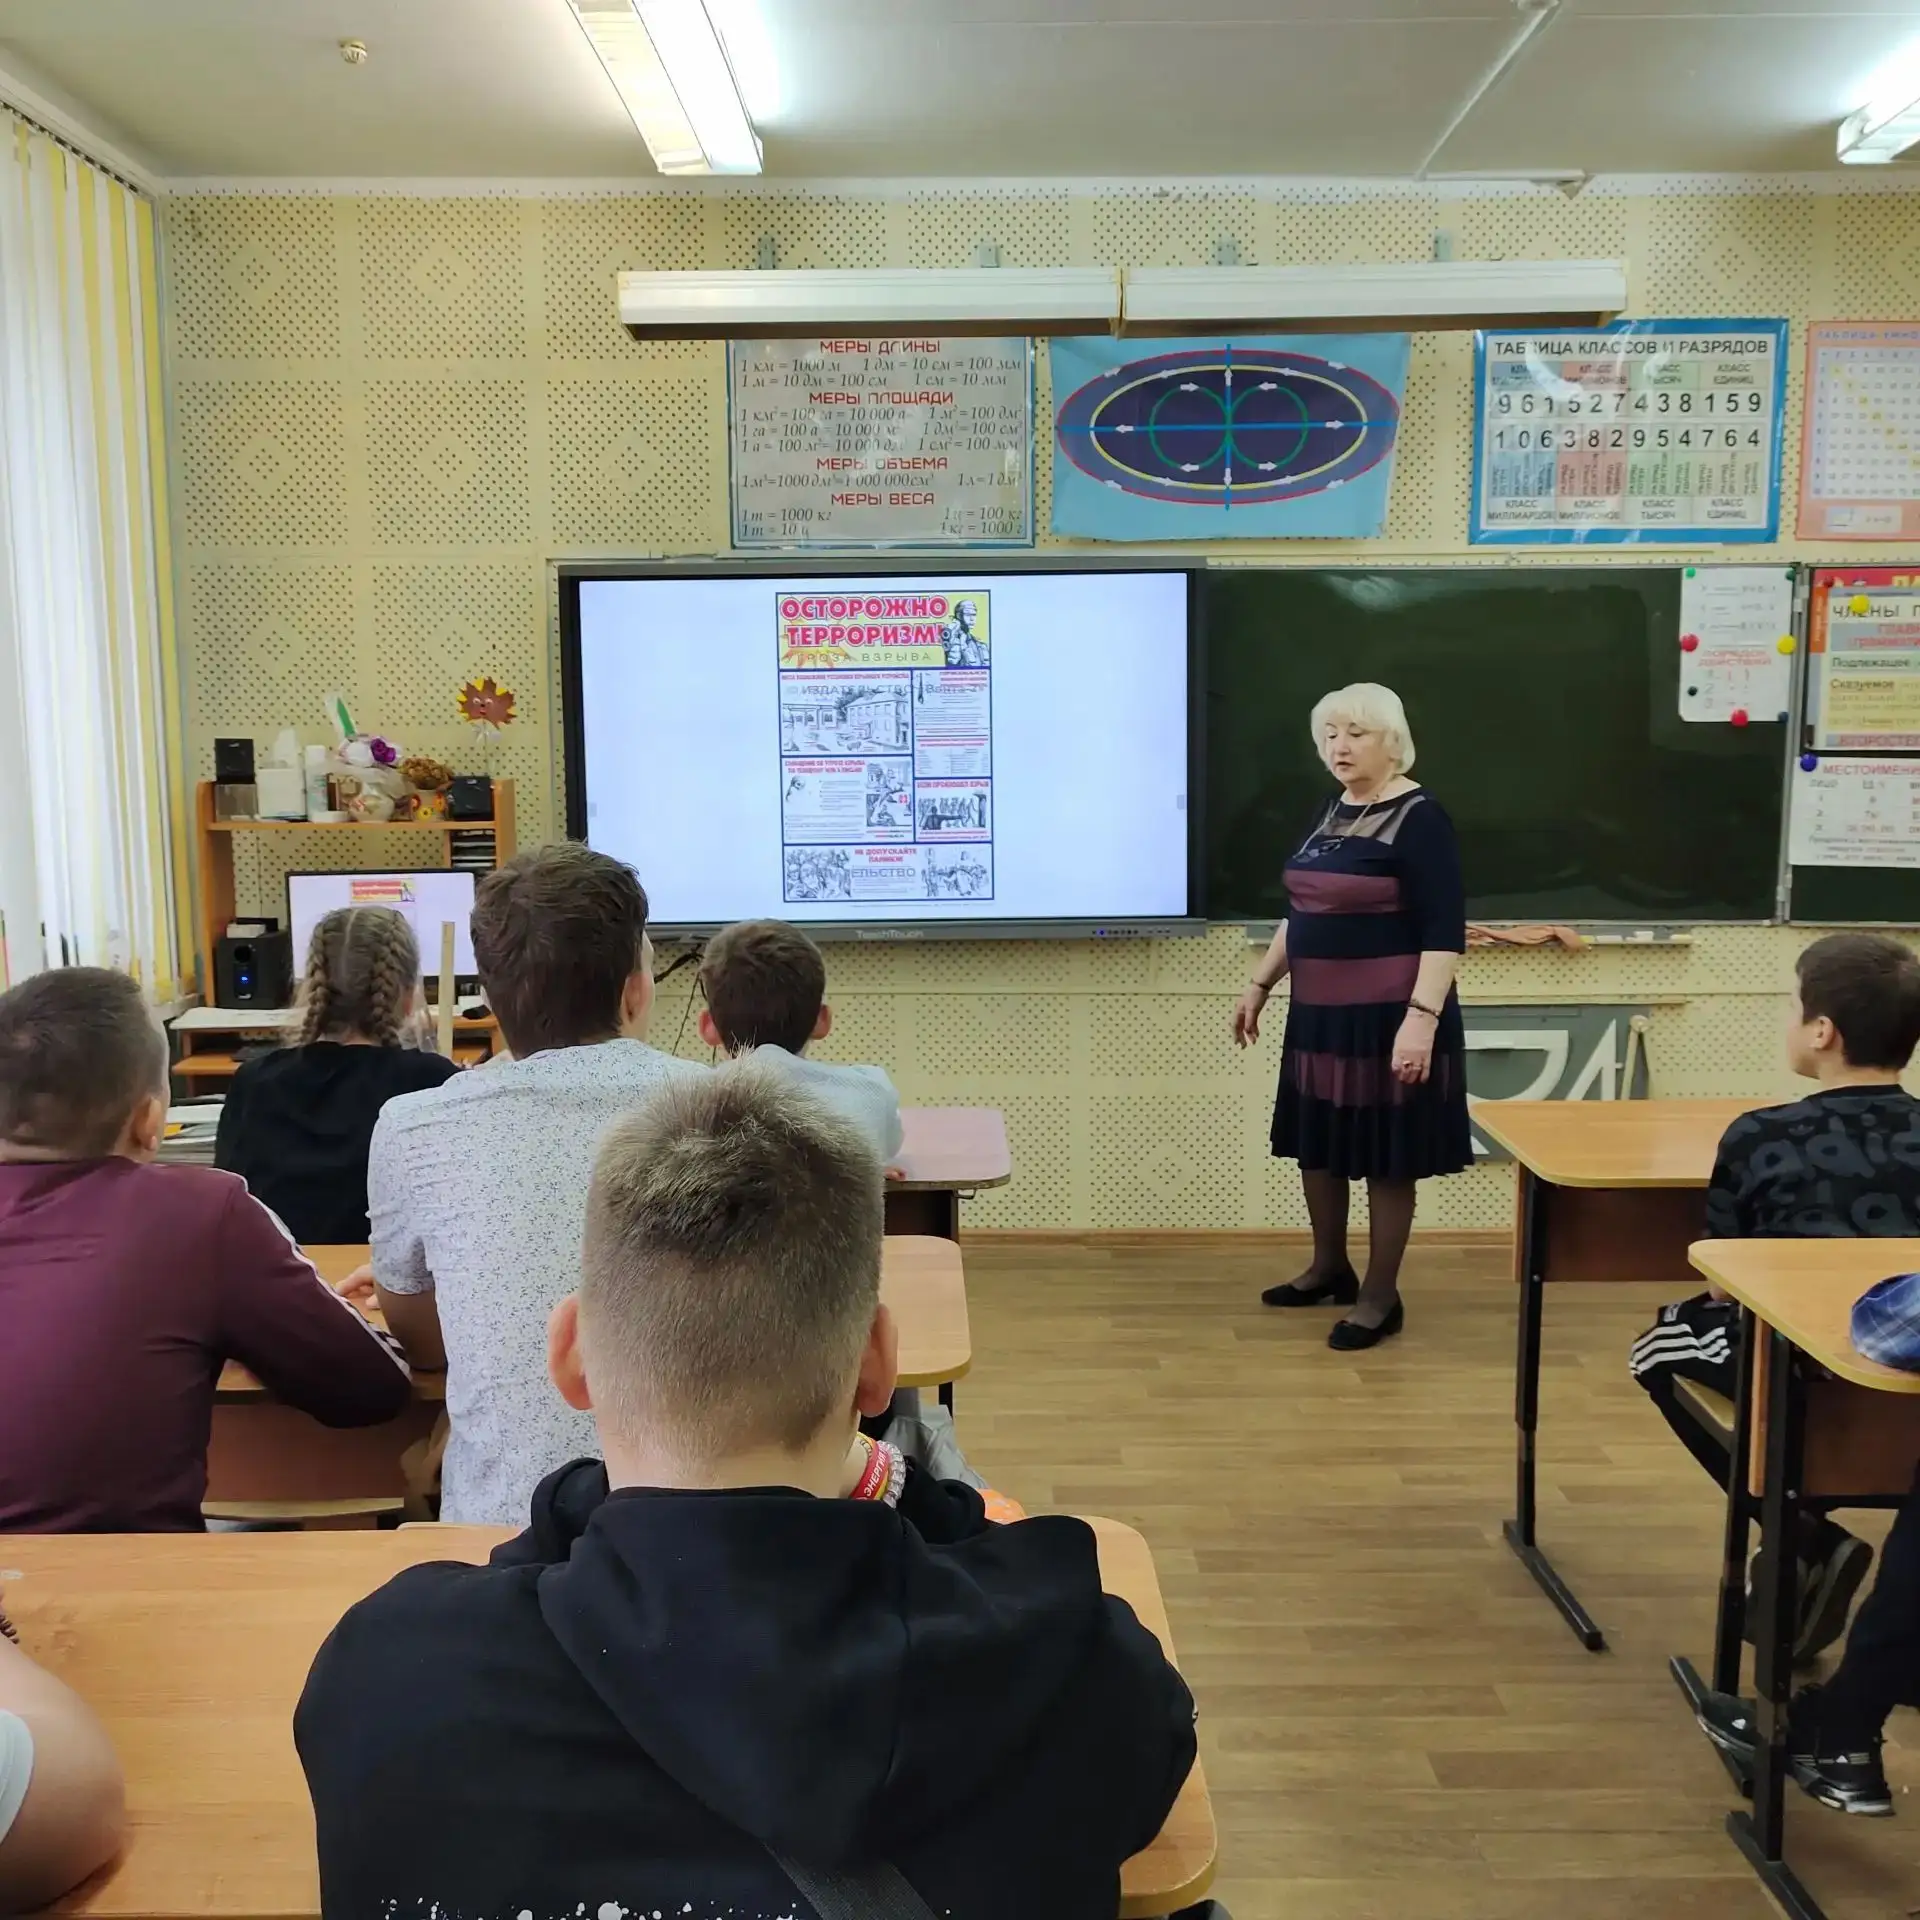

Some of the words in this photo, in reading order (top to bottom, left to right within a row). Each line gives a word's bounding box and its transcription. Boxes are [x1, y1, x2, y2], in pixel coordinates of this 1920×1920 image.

[820, 341, 870, 353] МЕРЫ
[1496, 342, 1573, 354] ТАБИЦА
[1579, 341, 1656, 354] КЛАССОВ
[1663, 342, 1674, 353] И
[1680, 341, 1767, 354] РАЗРЯДОВ
[742, 359, 747, 371] 1
[754, 362, 774, 372] км
[793, 359, 824, 371] 1000
[829, 362, 840, 371] м
[864, 358, 869, 370] 1
[875, 358, 893, 370] дм
[913, 357, 927, 369] 10
[932, 361, 950, 369] см
[969, 357, 992, 369] 100
[996, 360, 1021, 369] мм
[742, 375, 747, 387] 1
[753, 378, 764, 387] м
[784, 374, 799, 386] 10
[803, 374, 821, 386] дм
[841, 374, 864, 386] 100
[869, 377, 886, 386] см
[915, 373, 920, 385] 1
[926, 377, 943, 385] см
[963, 373, 977, 384] 10
[982, 376, 1006, 385] мм
[809, 393, 860, 404] МЕРЫ
[868, 392, 952, 405] ПЛОЩАДИ
[1499, 394, 1511, 413] 9
[1522, 394, 1534, 413] 6
[1544, 396, 1553, 412] 1
[1569, 394, 1580, 412] 5
[1591, 394, 1602, 412] 2
[1614, 394, 1625, 412] 7
[1635, 394, 1648, 412] 4
[1658, 394, 1669, 412] 3
[1680, 394, 1691, 412] 8
[1705, 394, 1714, 412] 1
[1726, 394, 1738, 412] 5
[1749, 393, 1760, 412] 9
[741, 409, 746, 420] 1
[792, 408, 815, 420] 100
[930, 407, 935, 419] 1
[972, 407, 994, 419] 100
[741, 425, 746, 437] 1
[753, 428, 765, 436] га
[784, 424, 806, 436] 100
[811, 427, 818, 435] а
[923, 423, 928, 434] 1
[973, 423, 995, 434] 100
[919, 438, 923, 450] 1
[967, 438, 990, 450] 100
[1496, 431, 1503, 448] 1
[1519, 431, 1530, 448] 0
[1541, 430, 1552, 447] 6
[1565, 430, 1575, 447] 3
[1588, 430, 1599, 447] 8
[1610, 430, 1623, 447] 2
[1634, 429, 1645, 447] 9
[1658, 429, 1668, 447] 5
[1679, 429, 1691, 447] 4
[1703, 430, 1713, 447] 7
[1725, 429, 1737, 446] 6
[1748, 429, 1760, 446] 4
[742, 440, 747, 452] 1
[778, 439, 800, 451] 100
[817, 458, 867, 470] МЕРЫ
[876, 457, 947, 469] ОБЪЕМА
[832, 494, 881, 505] МЕРЫ
[890, 493, 934, 505] ВЕСА
[781, 509, 813, 520] 1000
[818, 512, 831, 520] кг
[980, 507, 1003, 519] 100
[782, 523, 797, 535] 10
[981, 522, 1012, 534] 1000
[781, 595, 948, 619] ОСТОРОЖНО
[862, 653, 931, 662] ВЗРЫВА
